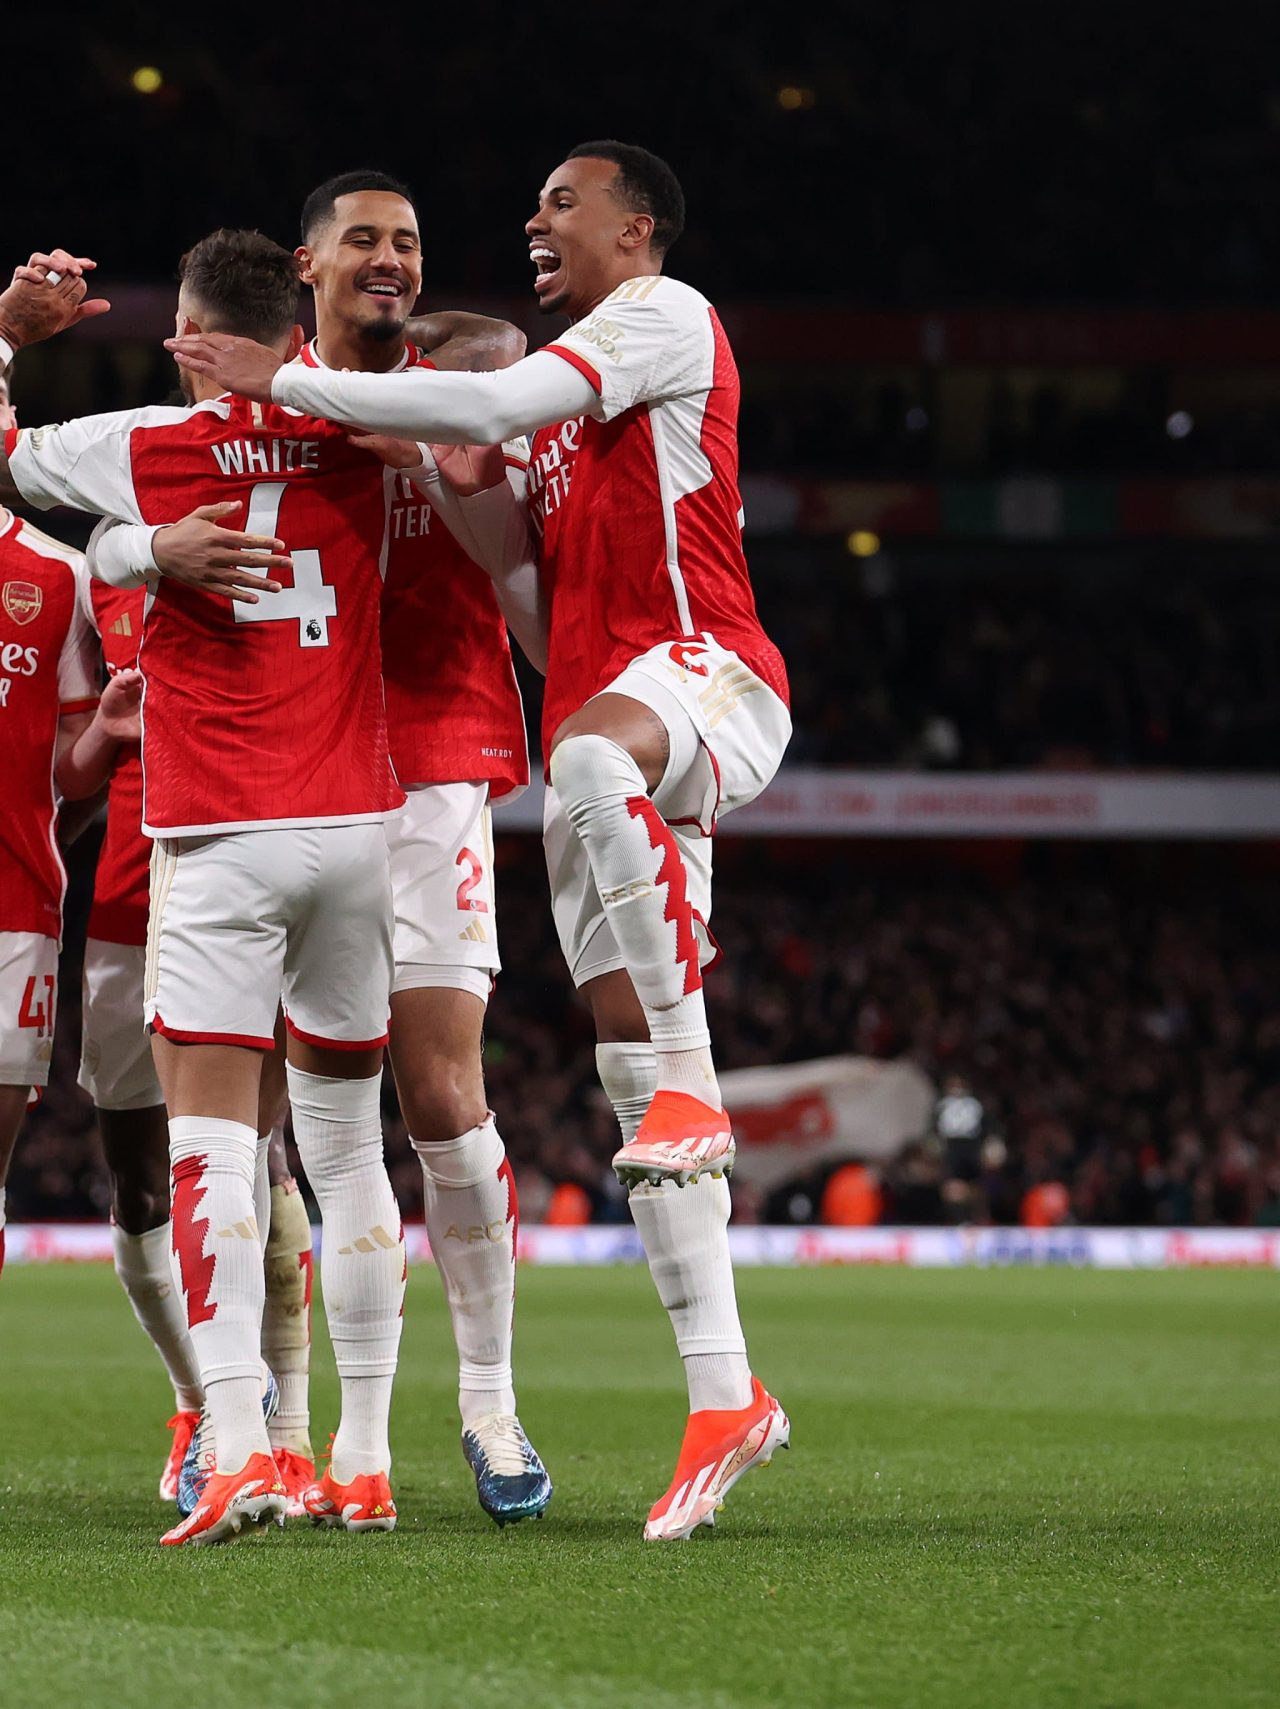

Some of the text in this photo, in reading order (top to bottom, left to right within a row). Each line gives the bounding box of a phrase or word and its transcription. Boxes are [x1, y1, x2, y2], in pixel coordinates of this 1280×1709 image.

[211, 438, 319, 476] WHITE
[232, 482, 338, 648] 4
[455, 847, 488, 913] 2
[18, 975, 55, 1037] 41
